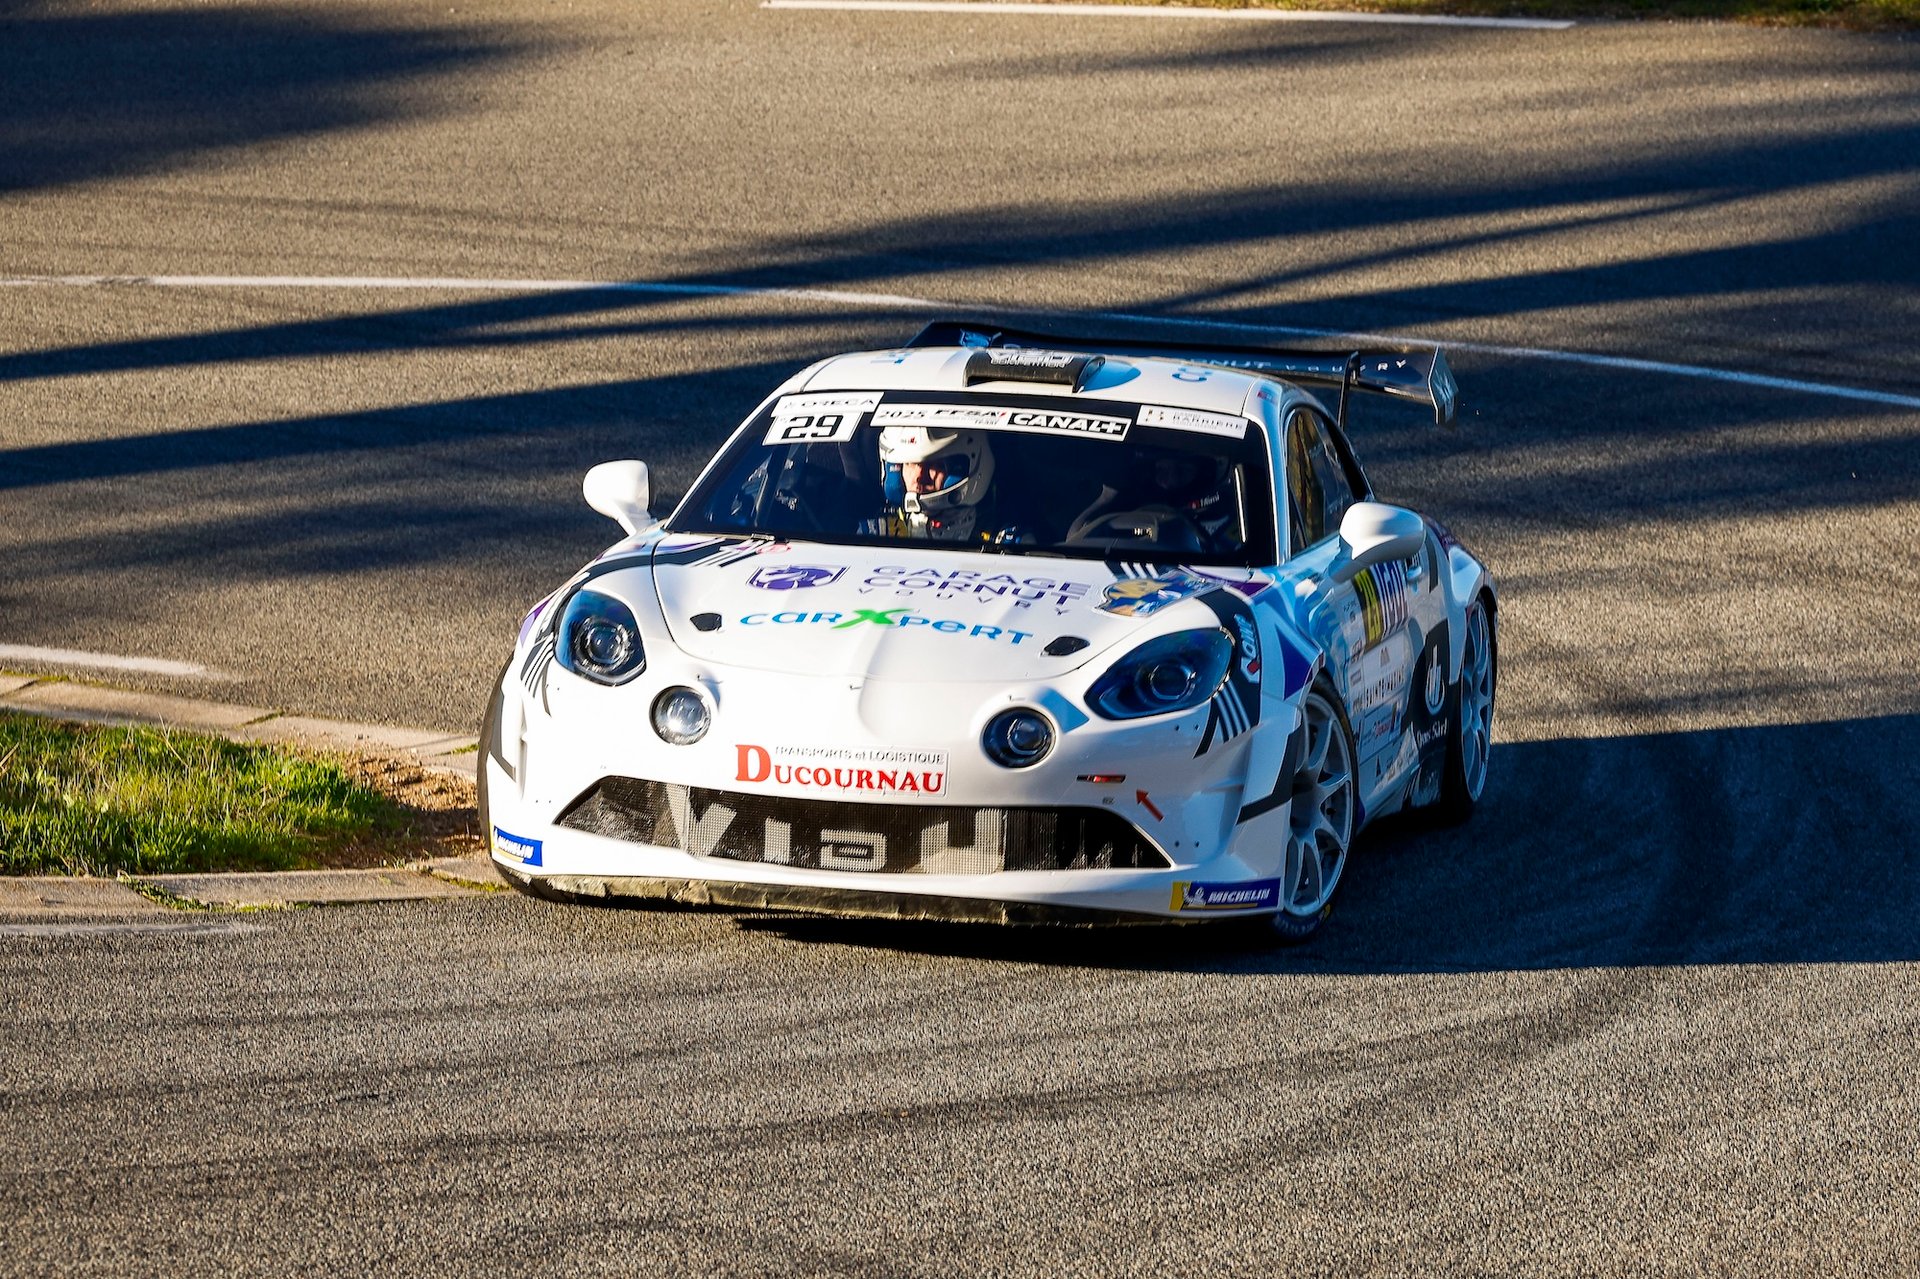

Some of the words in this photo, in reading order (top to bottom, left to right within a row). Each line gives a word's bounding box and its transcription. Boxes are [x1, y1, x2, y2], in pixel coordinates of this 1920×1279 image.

[878, 409, 927, 419] 2025
[1013, 413, 1122, 434] CANAL+
[781, 414, 844, 439] 29
[864, 577, 1079, 604] CORNUT
[873, 565, 1091, 595] GARAGE
[859, 587, 1072, 615] VOUVRY
[775, 746, 851, 759] TRANSPORTS
[868, 751, 945, 765] LOGISTIQUE
[1207, 887, 1271, 903] MICHELIN
